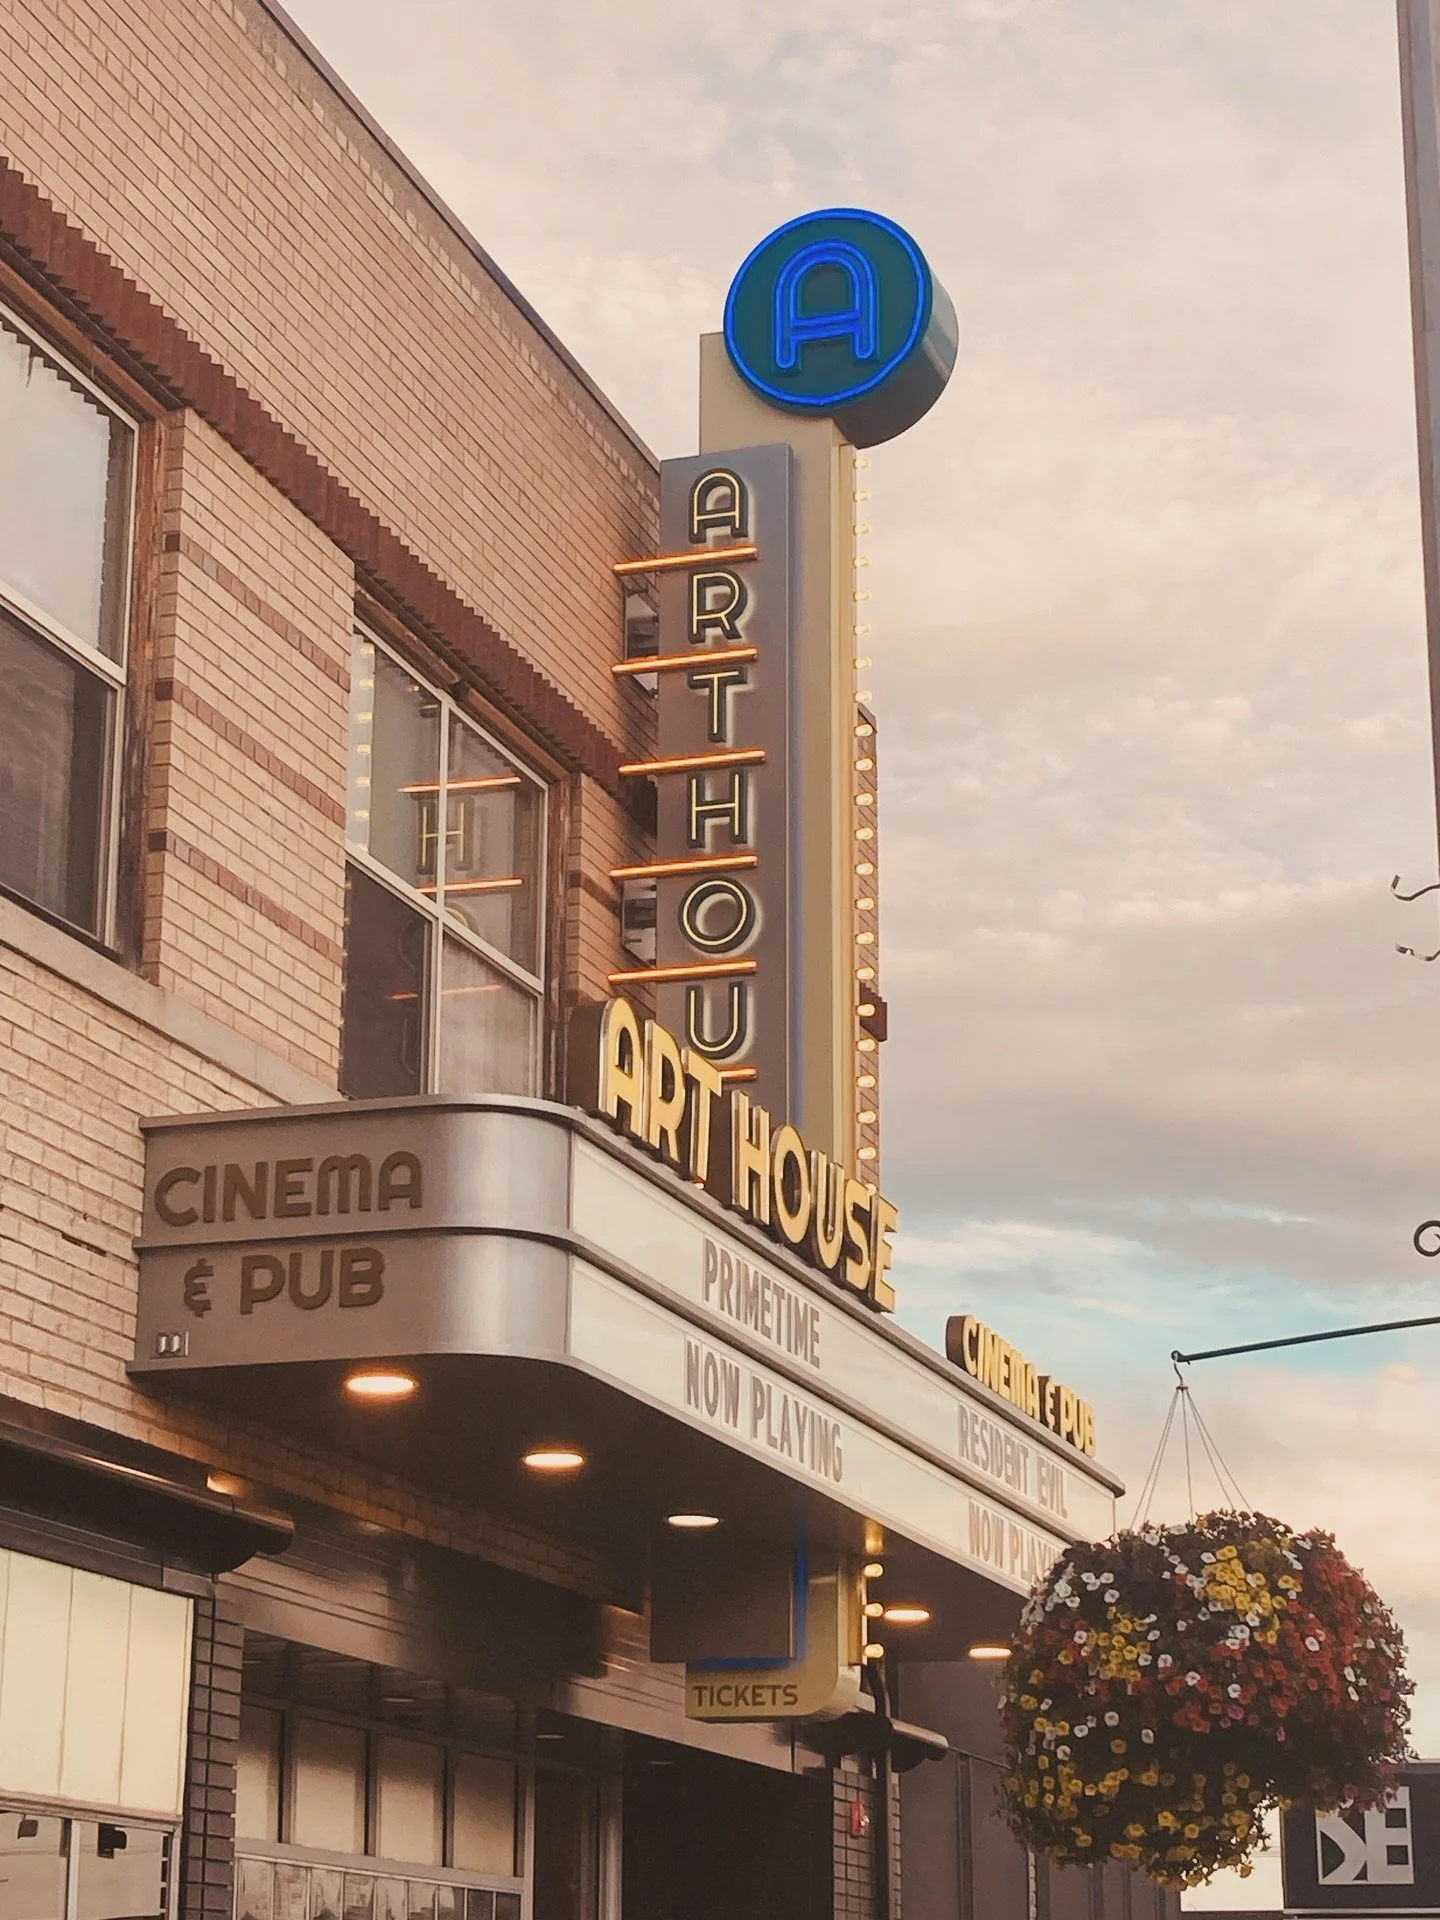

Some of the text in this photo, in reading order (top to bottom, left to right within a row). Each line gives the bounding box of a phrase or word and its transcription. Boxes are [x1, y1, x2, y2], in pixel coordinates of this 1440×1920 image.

[772, 238, 879, 374] A
[153, 1150, 424, 1228] CINEMA
[599, 998, 898, 1312] ART HOUSE
[239, 1247, 386, 1316] PUB
[704, 1238, 820, 1369] PRIMETIME
[686, 1340, 843, 1482] NOW PLAYING
[956, 1315, 1040, 1421] CINEMA
[1060, 1384, 1096, 1458] PUB
[958, 1402, 1067, 1519] RESIDENT EVIL
[968, 1499, 1004, 1569] NOW
[693, 1684, 798, 1707] TICKETS
